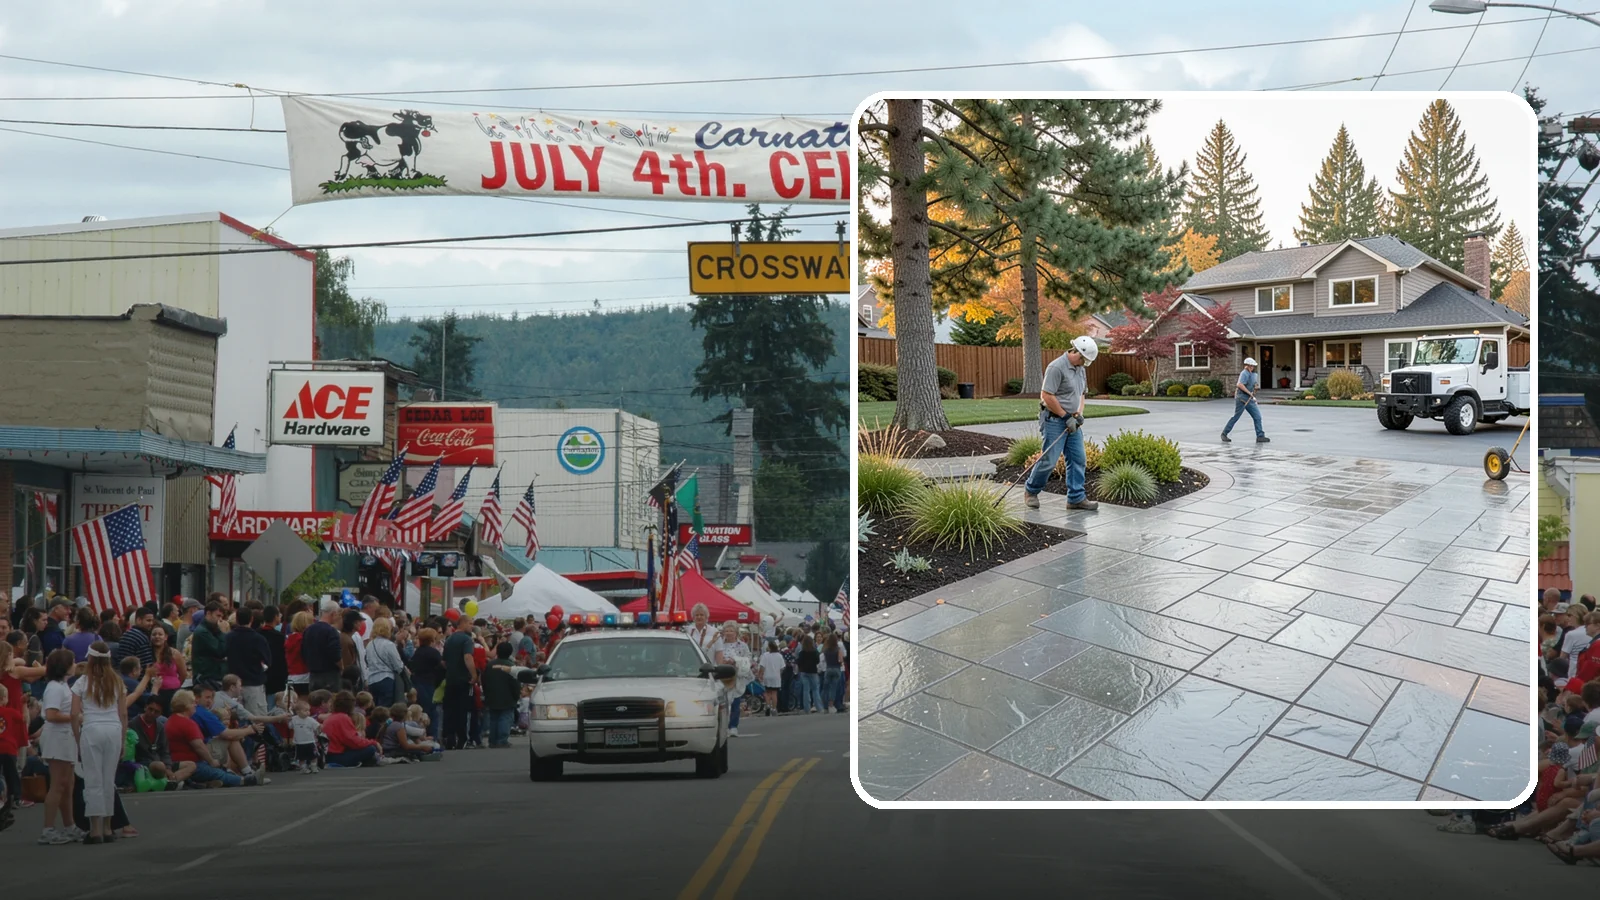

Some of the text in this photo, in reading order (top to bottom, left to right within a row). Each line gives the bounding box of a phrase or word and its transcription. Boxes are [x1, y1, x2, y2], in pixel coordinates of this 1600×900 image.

[481, 140, 605, 193] JULY
[632, 150, 746, 197] 4th.
[697, 254, 850, 280] CROSSWA
[283, 380, 373, 419] ACE
[406, 409, 452, 422] CEDAR
[283, 421, 370, 436] Hardware
[416, 428, 477, 447] Coca-Cola
[353, 467, 384, 480] Simpl
[83, 484, 155, 495] St. Vincent de Paul
[688, 526, 741, 535] CRNATION
